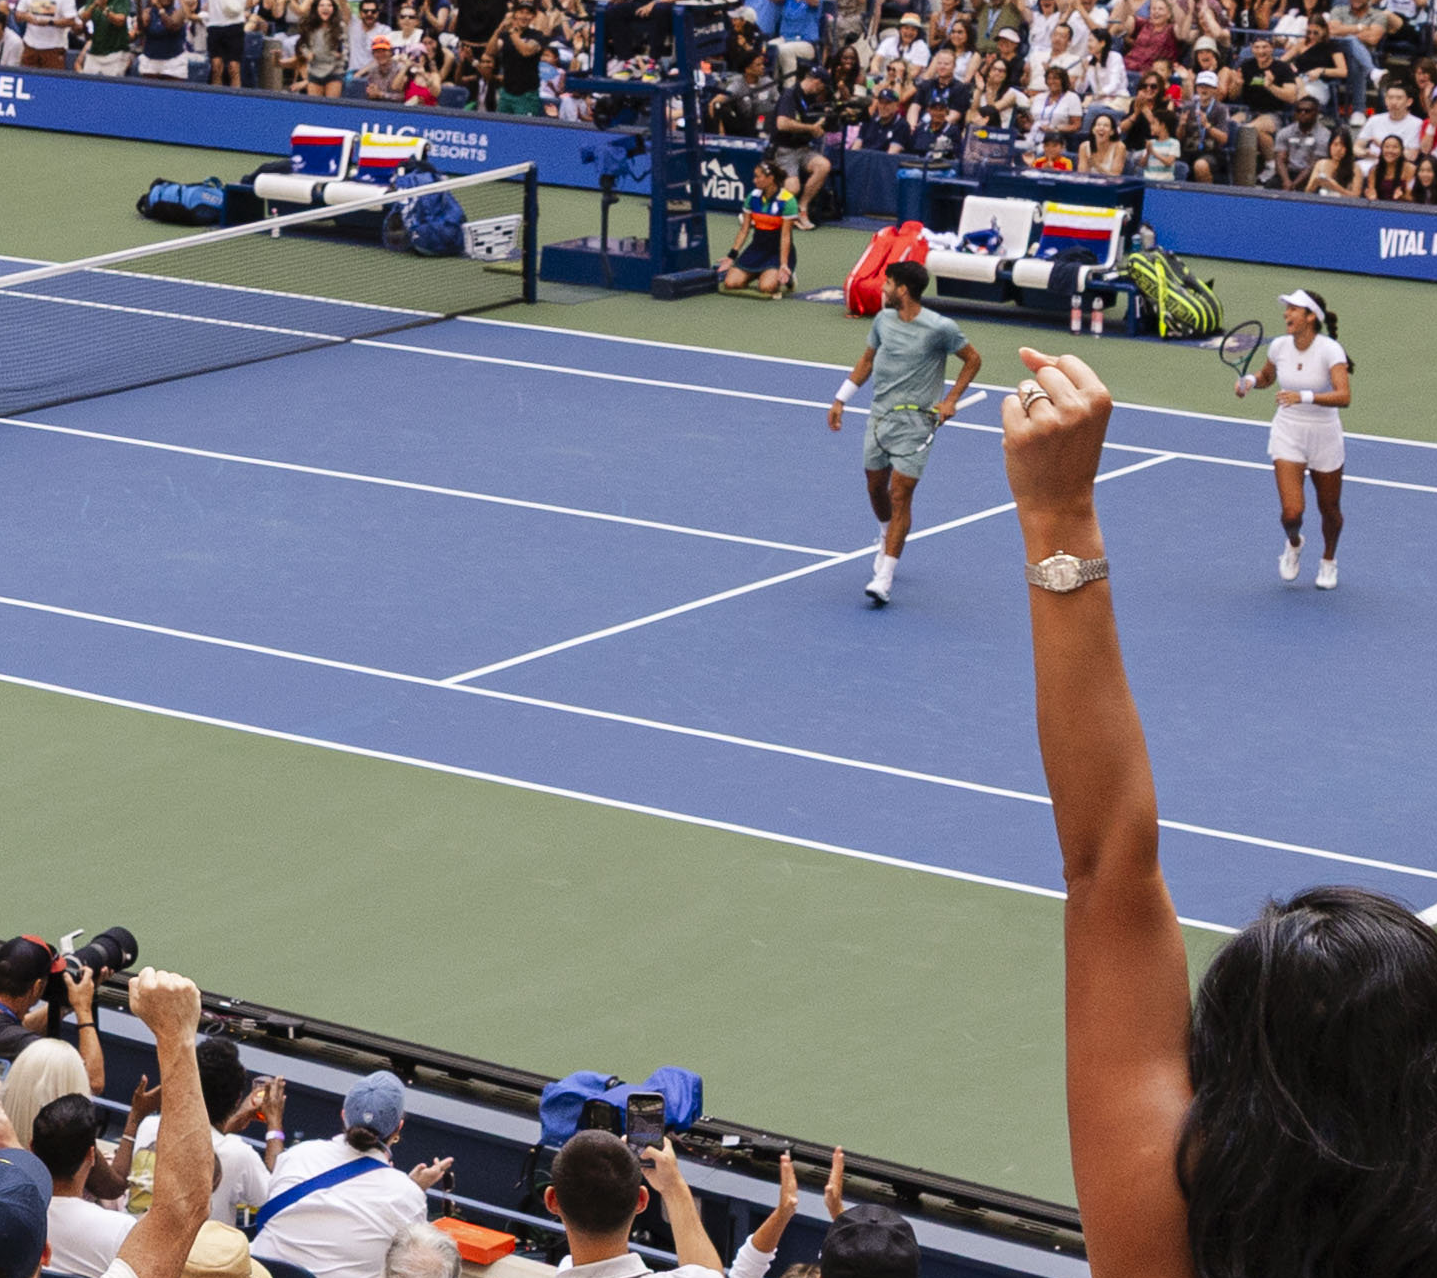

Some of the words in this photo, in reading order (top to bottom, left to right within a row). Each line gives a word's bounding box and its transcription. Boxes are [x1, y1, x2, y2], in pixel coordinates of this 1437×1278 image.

[422, 127, 476, 147] HOTELS
[478, 133, 489, 147] &
[427, 142, 488, 163] ESORTS
[689, 169, 746, 202] vian
[1380, 227, 1428, 259] VITAL
